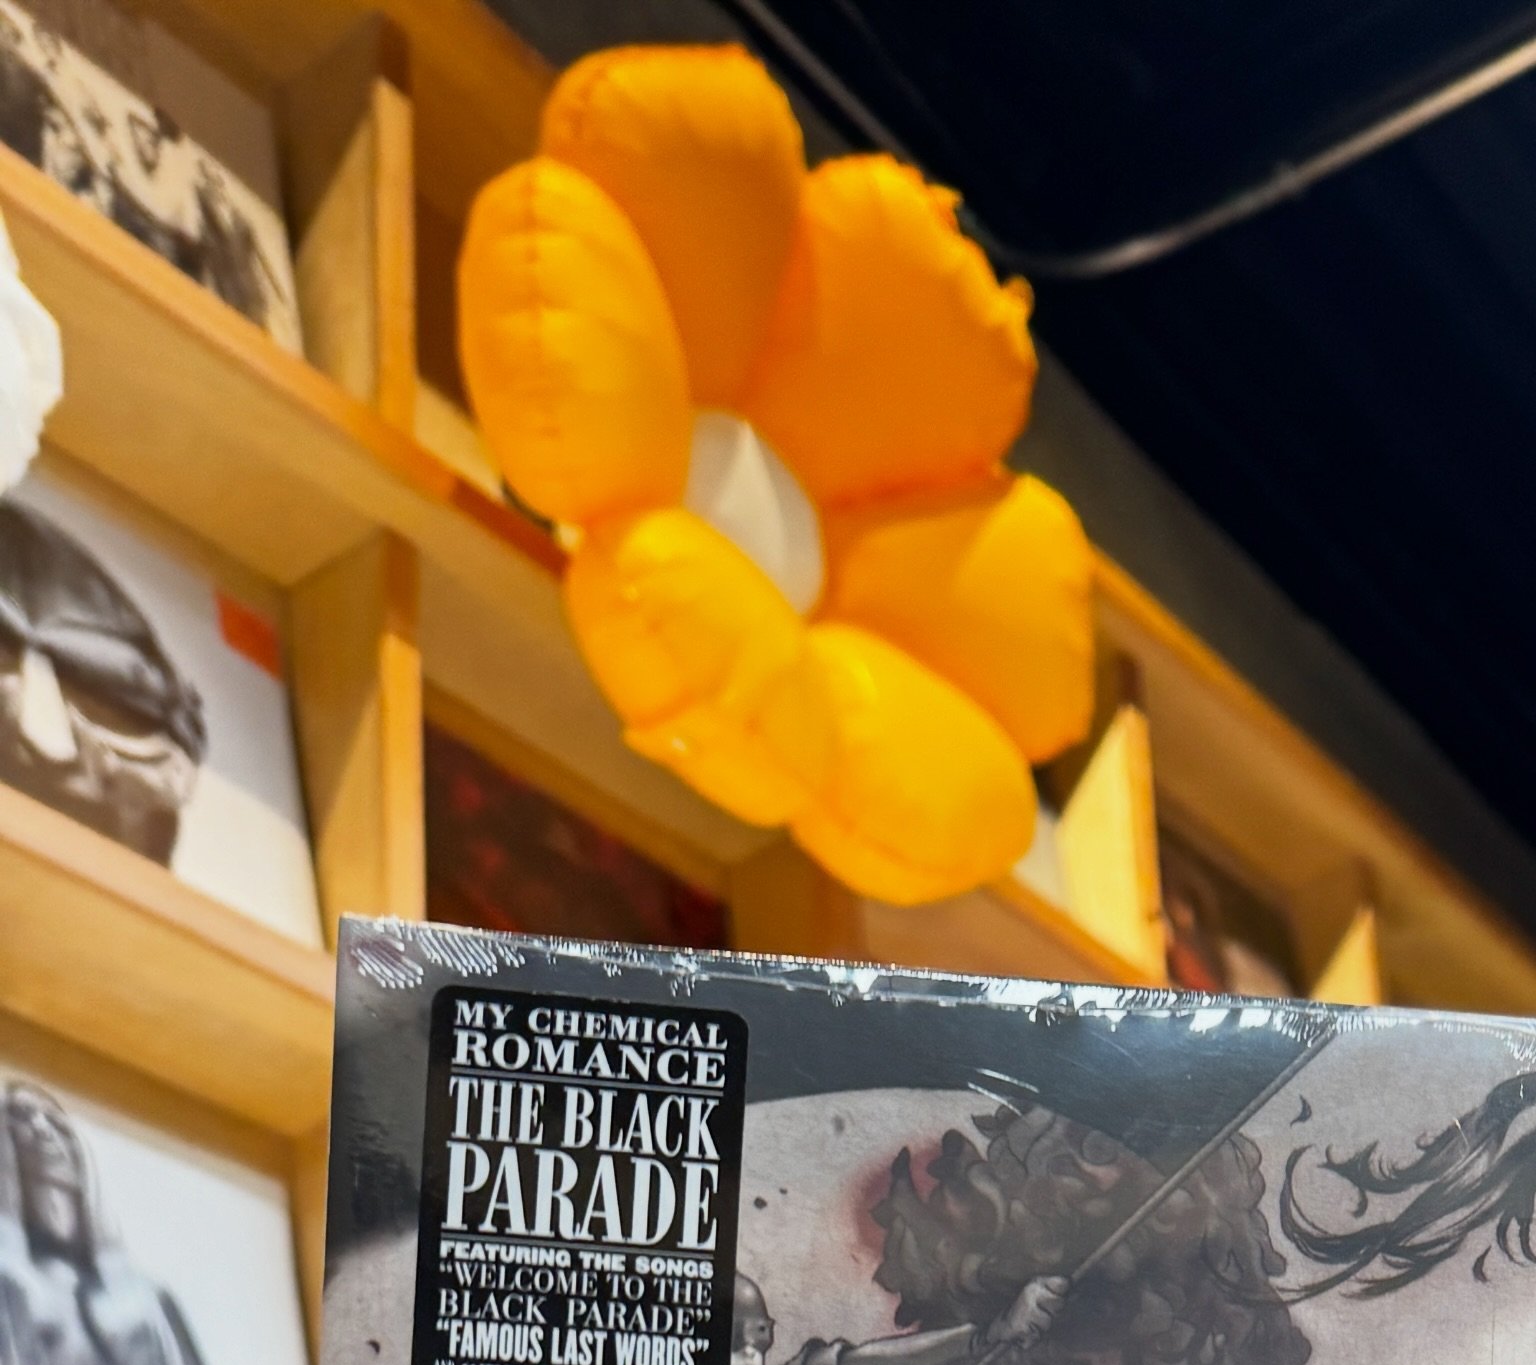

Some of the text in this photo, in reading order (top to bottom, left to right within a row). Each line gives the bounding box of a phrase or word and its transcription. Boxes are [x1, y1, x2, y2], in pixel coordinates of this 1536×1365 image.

[455, 999, 728, 1050] MY CHEMICAL
[451, 1028, 726, 1089] ROMANCE
[448, 1075, 720, 1160] THE BLACK
[440, 1140, 720, 1251] PARADE
[439, 1240, 715, 1279] FEATURING THE SONGS
[439, 1262, 713, 1307] “WELCOME TO THE
[438, 1288, 712, 1337] BLACK PARADE”
[435, 1318, 544, 1364] “FAMOUS
